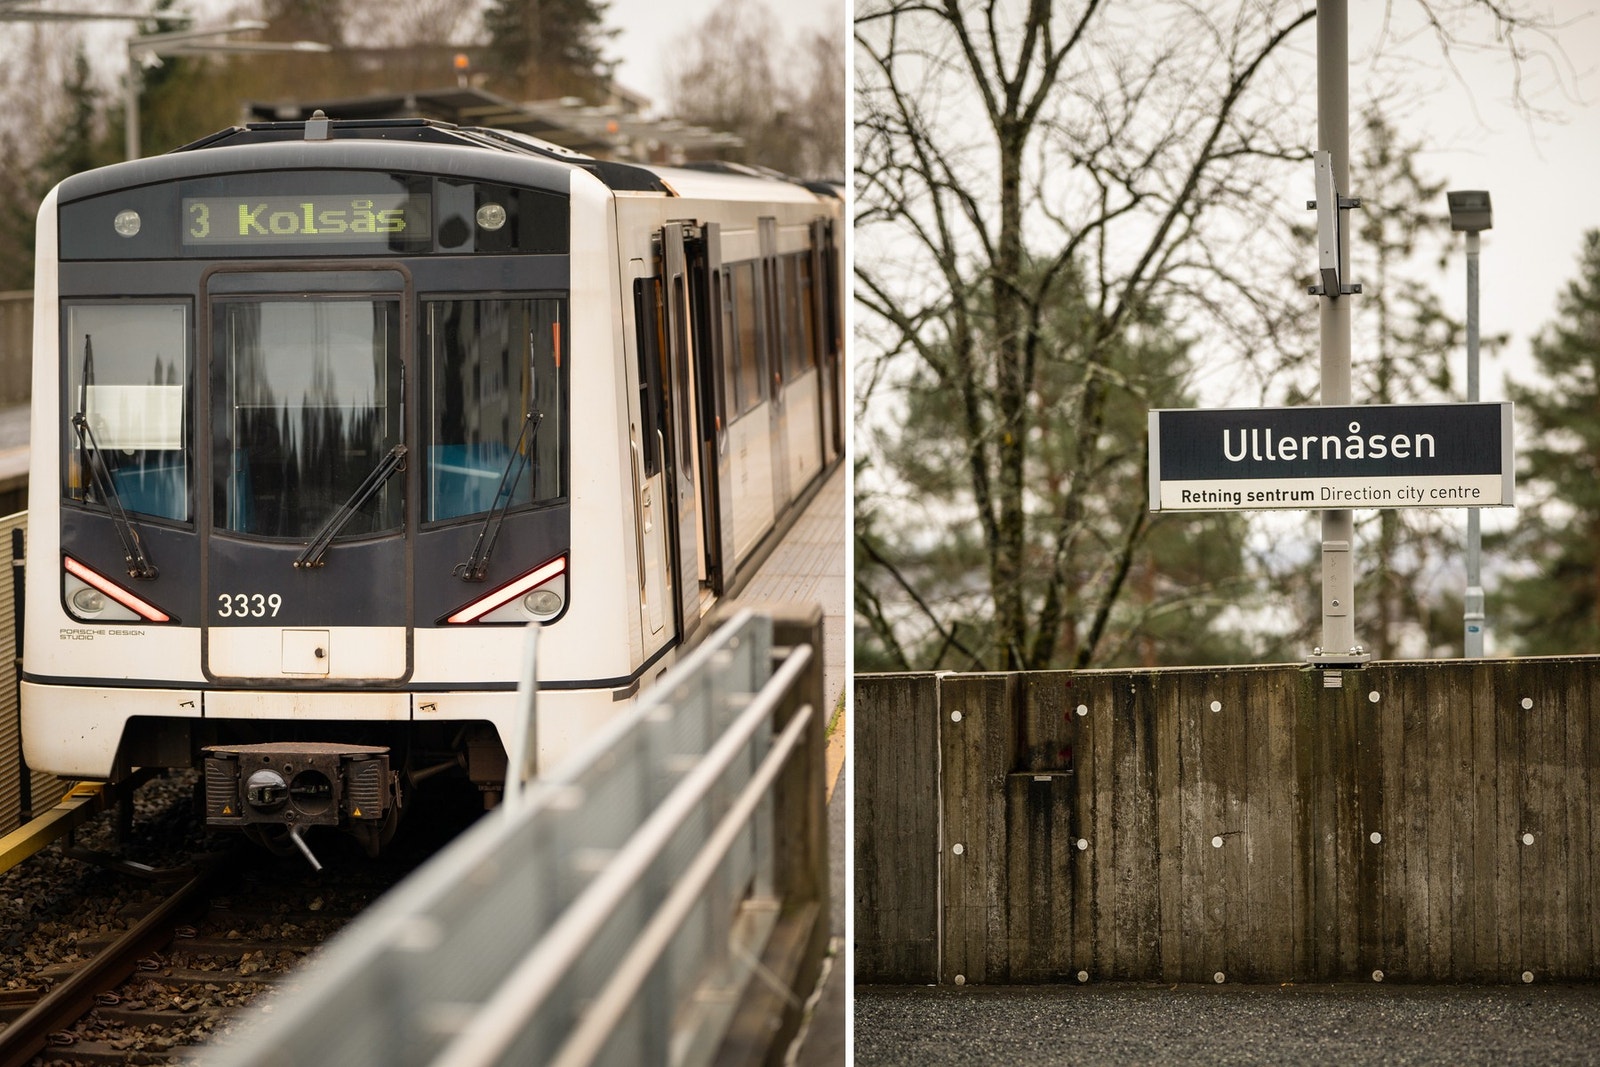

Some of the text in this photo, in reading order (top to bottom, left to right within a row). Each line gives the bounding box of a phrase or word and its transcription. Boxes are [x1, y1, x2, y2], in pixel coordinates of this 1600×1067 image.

[189, 199, 407, 239] 3 Kolsås
[1223, 421, 1436, 462] Ullernåsen
[1181, 485, 1481, 506] Retning sentrum Direction city centre
[217, 593, 282, 618] 3339
[59, 628, 106, 636] PORSCHE
